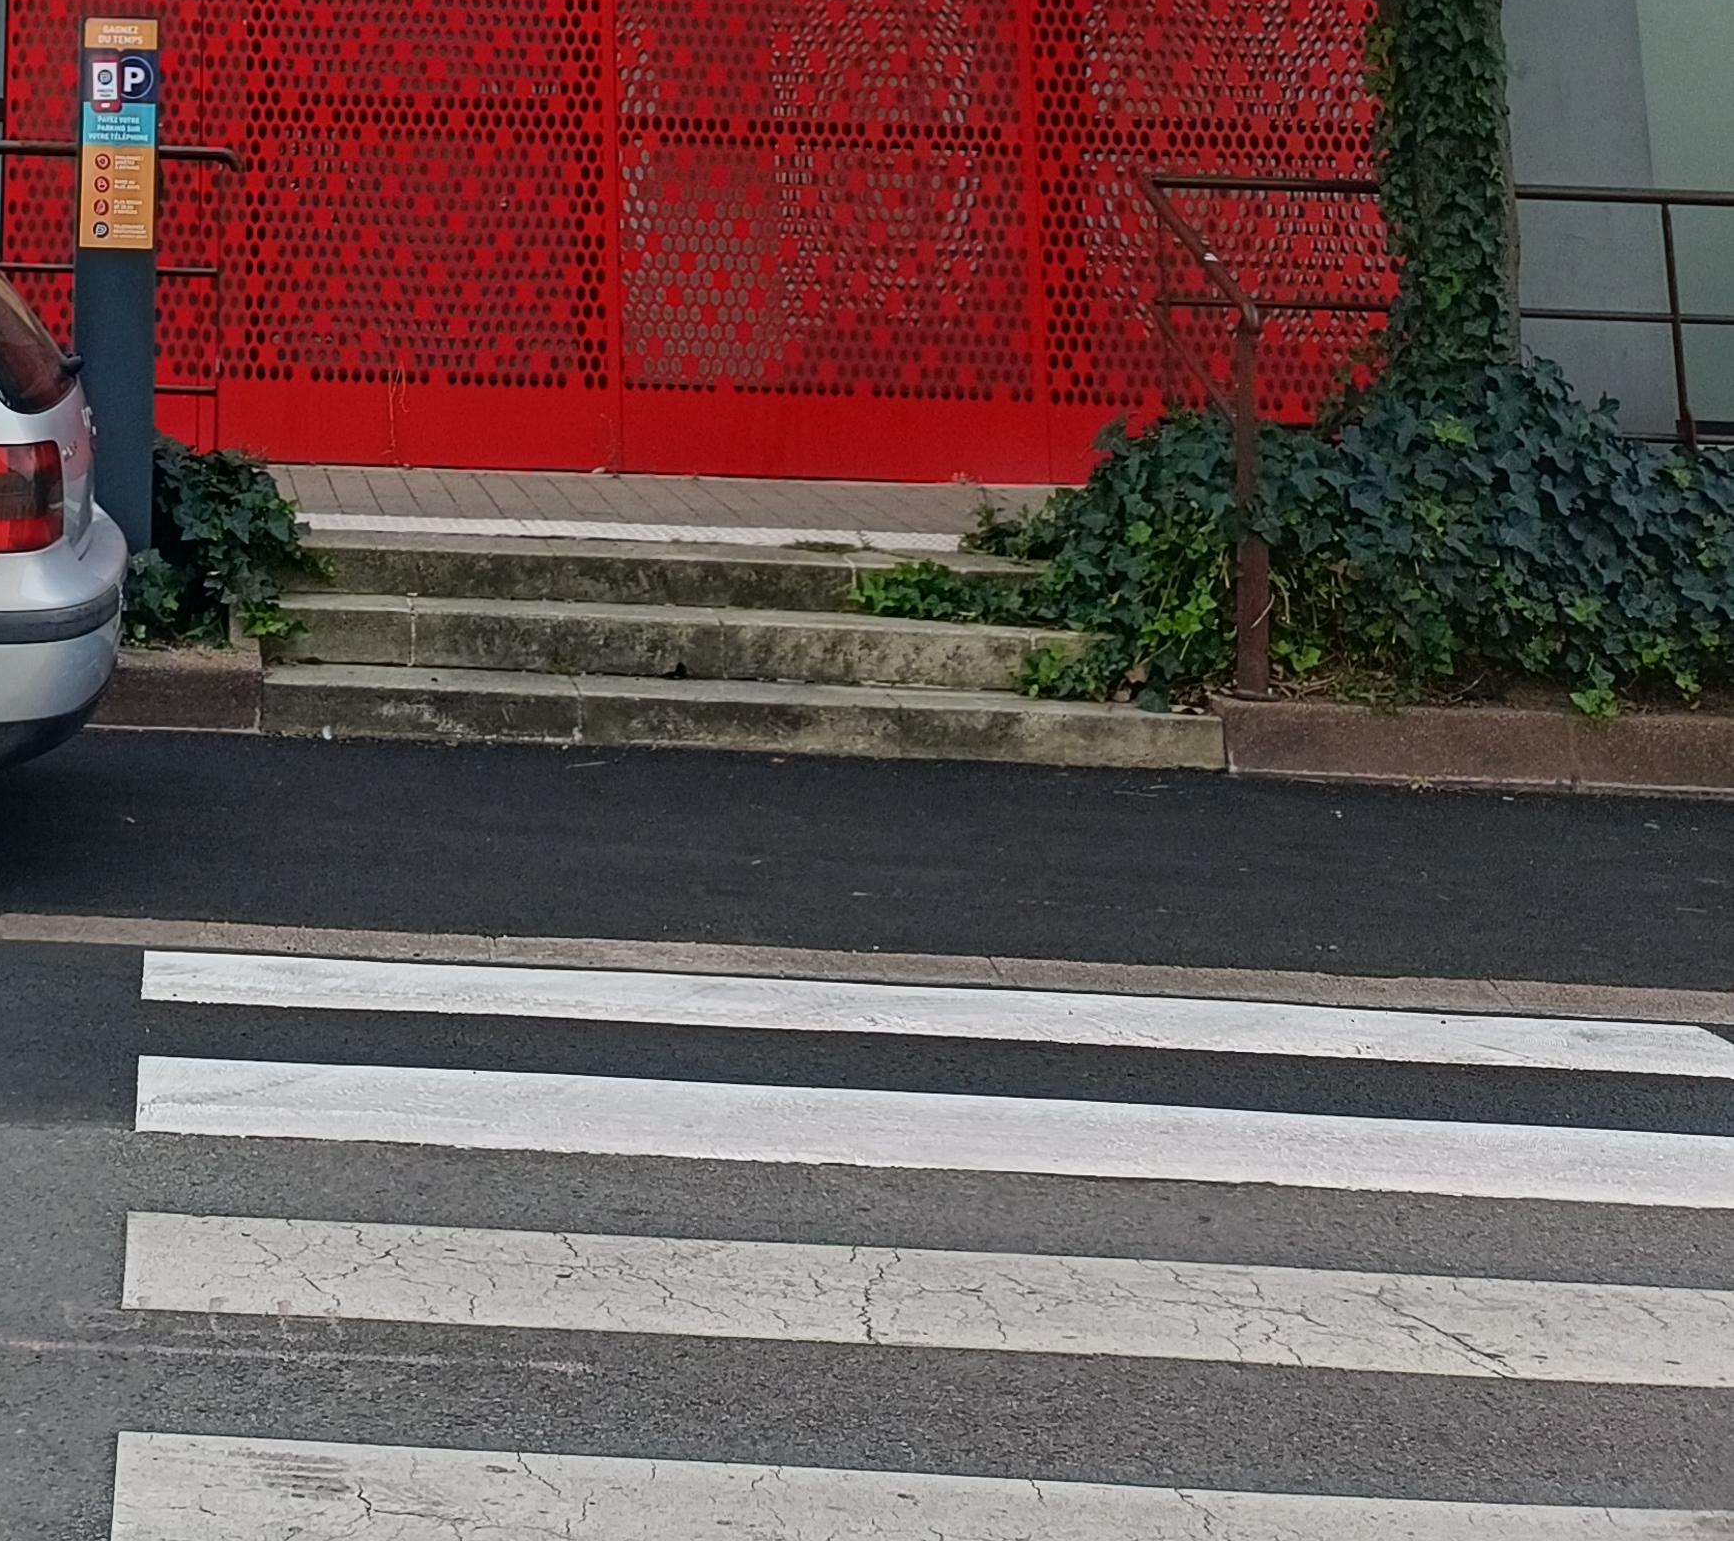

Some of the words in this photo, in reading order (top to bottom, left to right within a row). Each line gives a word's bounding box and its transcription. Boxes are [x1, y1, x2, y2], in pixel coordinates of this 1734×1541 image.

[102, 24, 139, 34] GAGNEZ
[97, 34, 111, 44] DU
[112, 35, 143, 45] TEMPS
[124, 66, 145, 92] P
